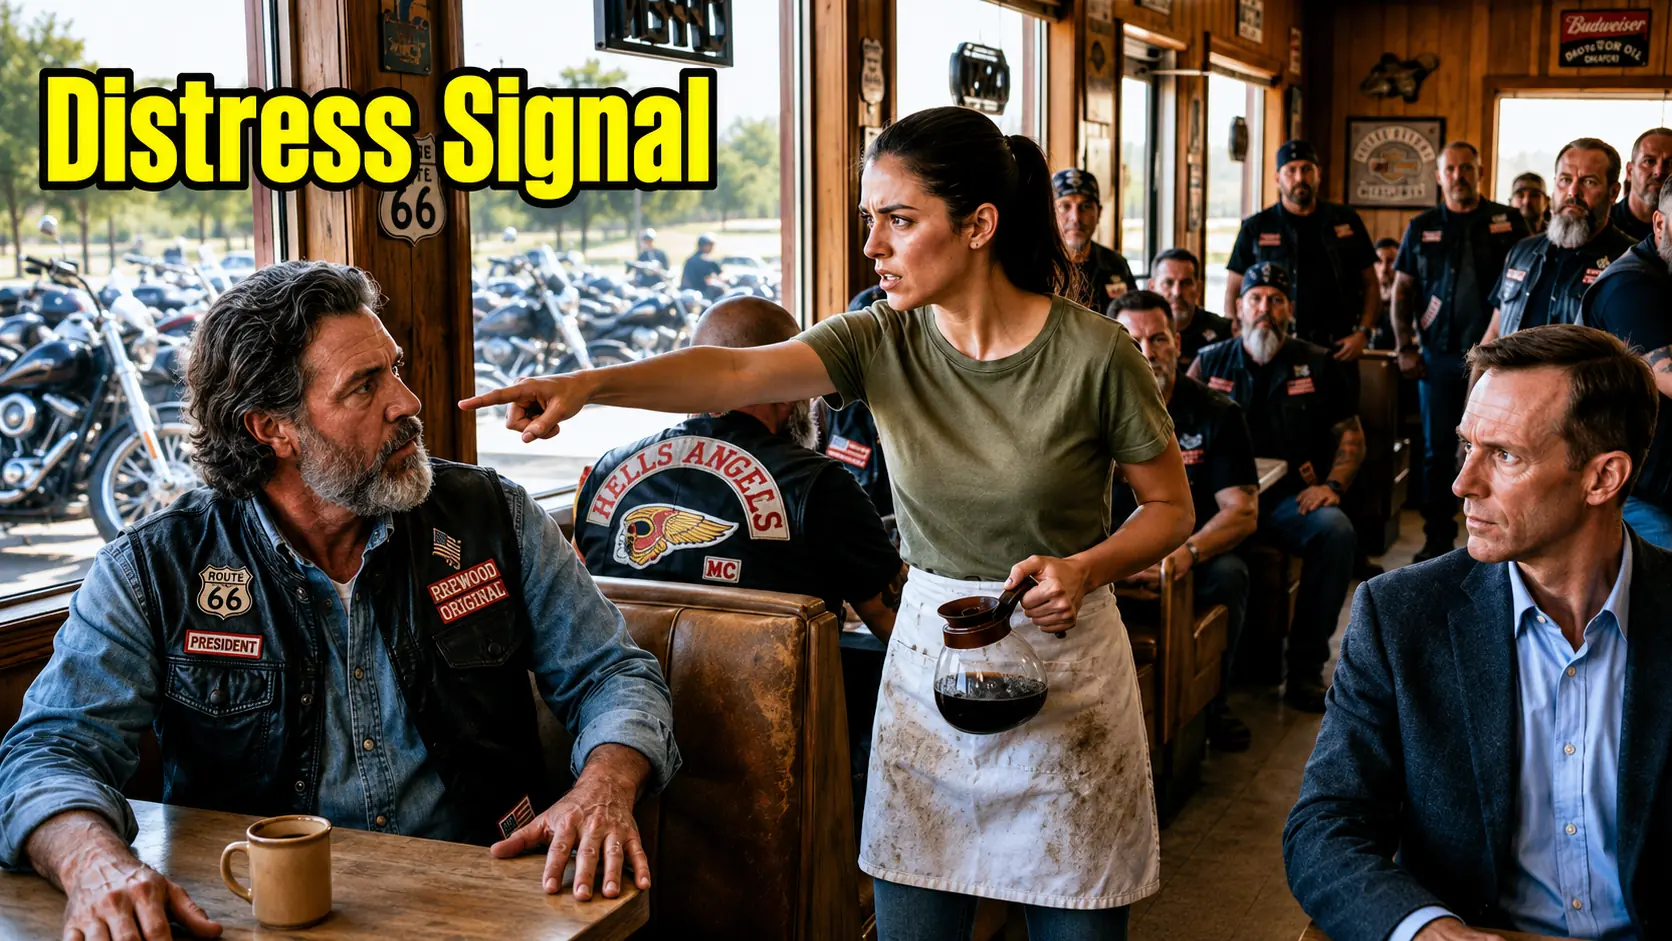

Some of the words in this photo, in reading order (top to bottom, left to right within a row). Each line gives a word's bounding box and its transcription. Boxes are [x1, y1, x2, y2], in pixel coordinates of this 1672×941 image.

[1565, 15, 1646, 35] Budweiser
[391, 186, 436, 230] 66
[591, 442, 673, 520] HELLS
[682, 441, 784, 532] ANGELS
[207, 571, 245, 583] ROUTE
[706, 559, 736, 579] MC
[207, 586, 243, 611] 66
[439, 580, 506, 621] ORIGINAL
[190, 635, 258, 654] PRESIDENT
